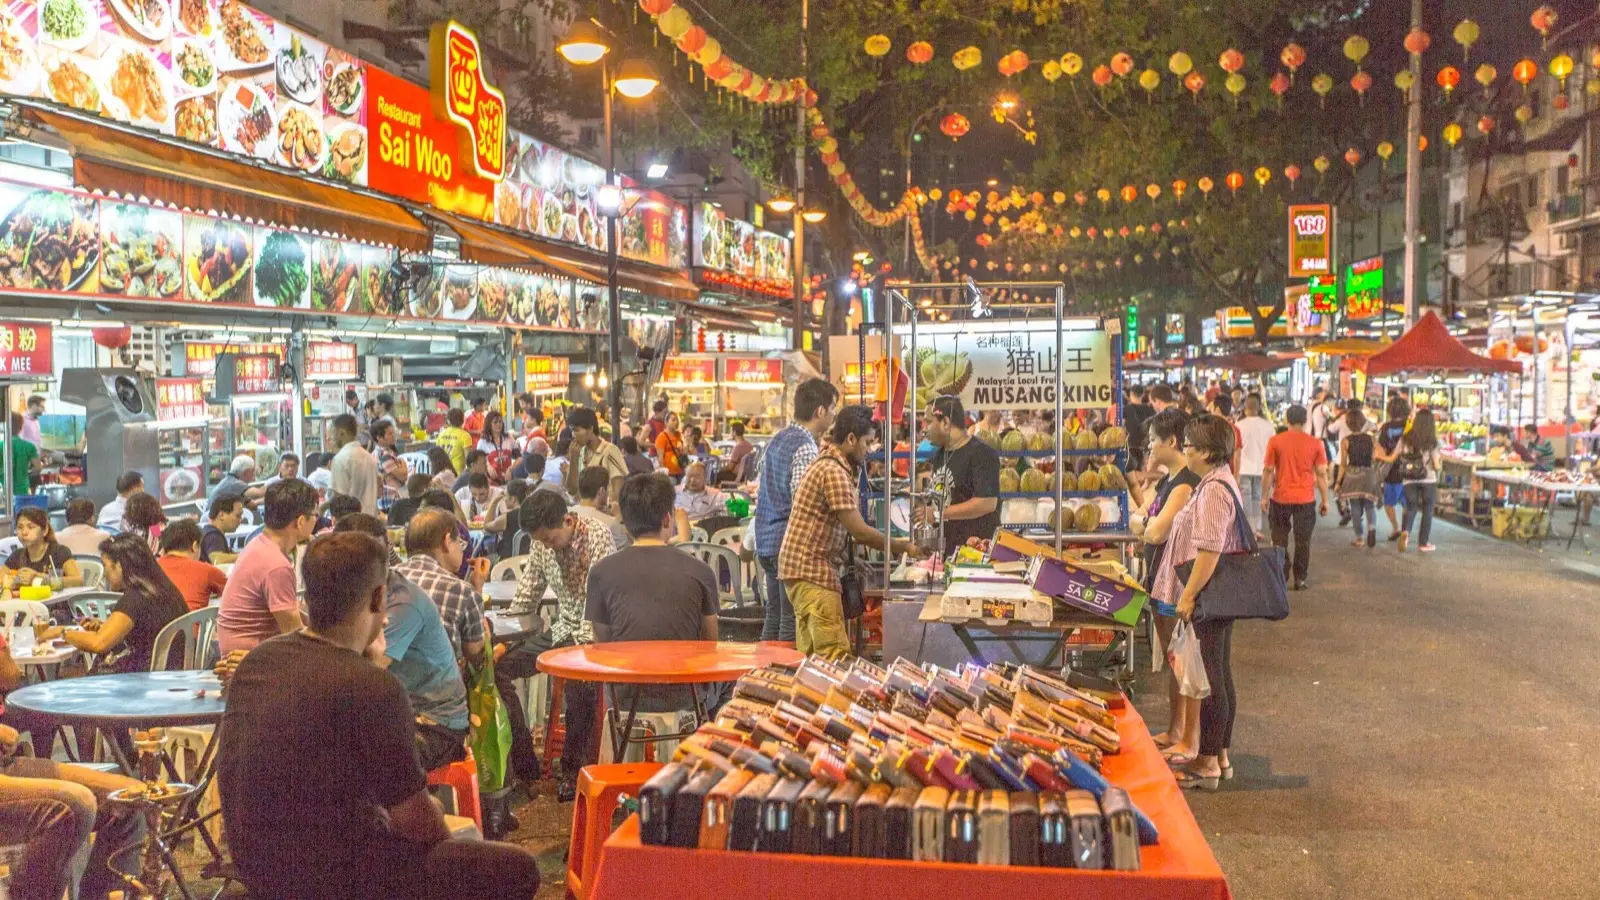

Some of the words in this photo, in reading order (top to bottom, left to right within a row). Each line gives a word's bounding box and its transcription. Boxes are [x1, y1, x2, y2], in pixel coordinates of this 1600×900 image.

[378, 95, 422, 129] Restaurant
[379, 121, 411, 169] Sai
[415, 133, 452, 181] Woo
[11, 356, 32, 372] MEE
[1006, 347, 1094, 376] 猫山王
[734, 371, 773, 383] SATAY
[977, 376, 1015, 386] Malaysia
[973, 386, 1057, 405] MUSANG
